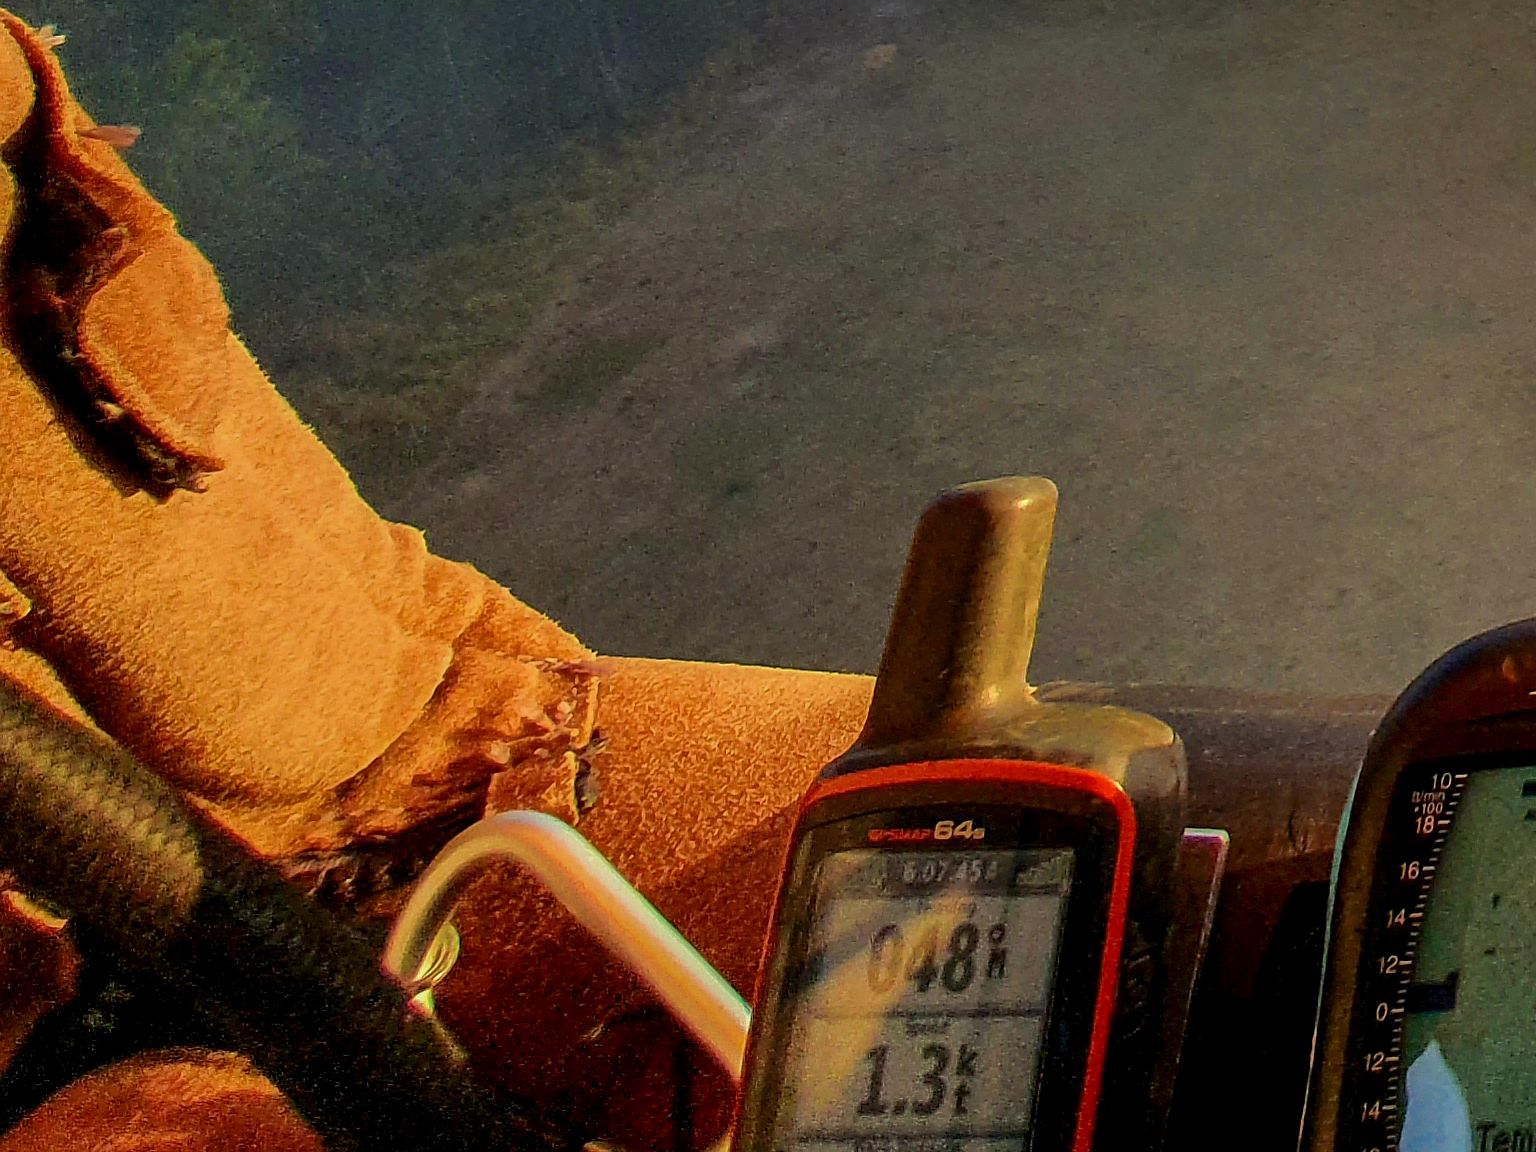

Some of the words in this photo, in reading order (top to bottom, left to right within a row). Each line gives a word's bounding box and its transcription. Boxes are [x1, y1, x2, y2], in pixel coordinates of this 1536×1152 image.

[1432, 772, 1452, 789] 10
[1416, 815, 1435, 834] 18
[1400, 860, 1420, 880] 16
[1387, 908, 1406, 929] 14
[1379, 955, 1399, 974] 12
[1364, 1051, 1385, 1072] 12
[856, 1043, 949, 1116] 1.3
[1361, 1100, 1381, 1122] 14
